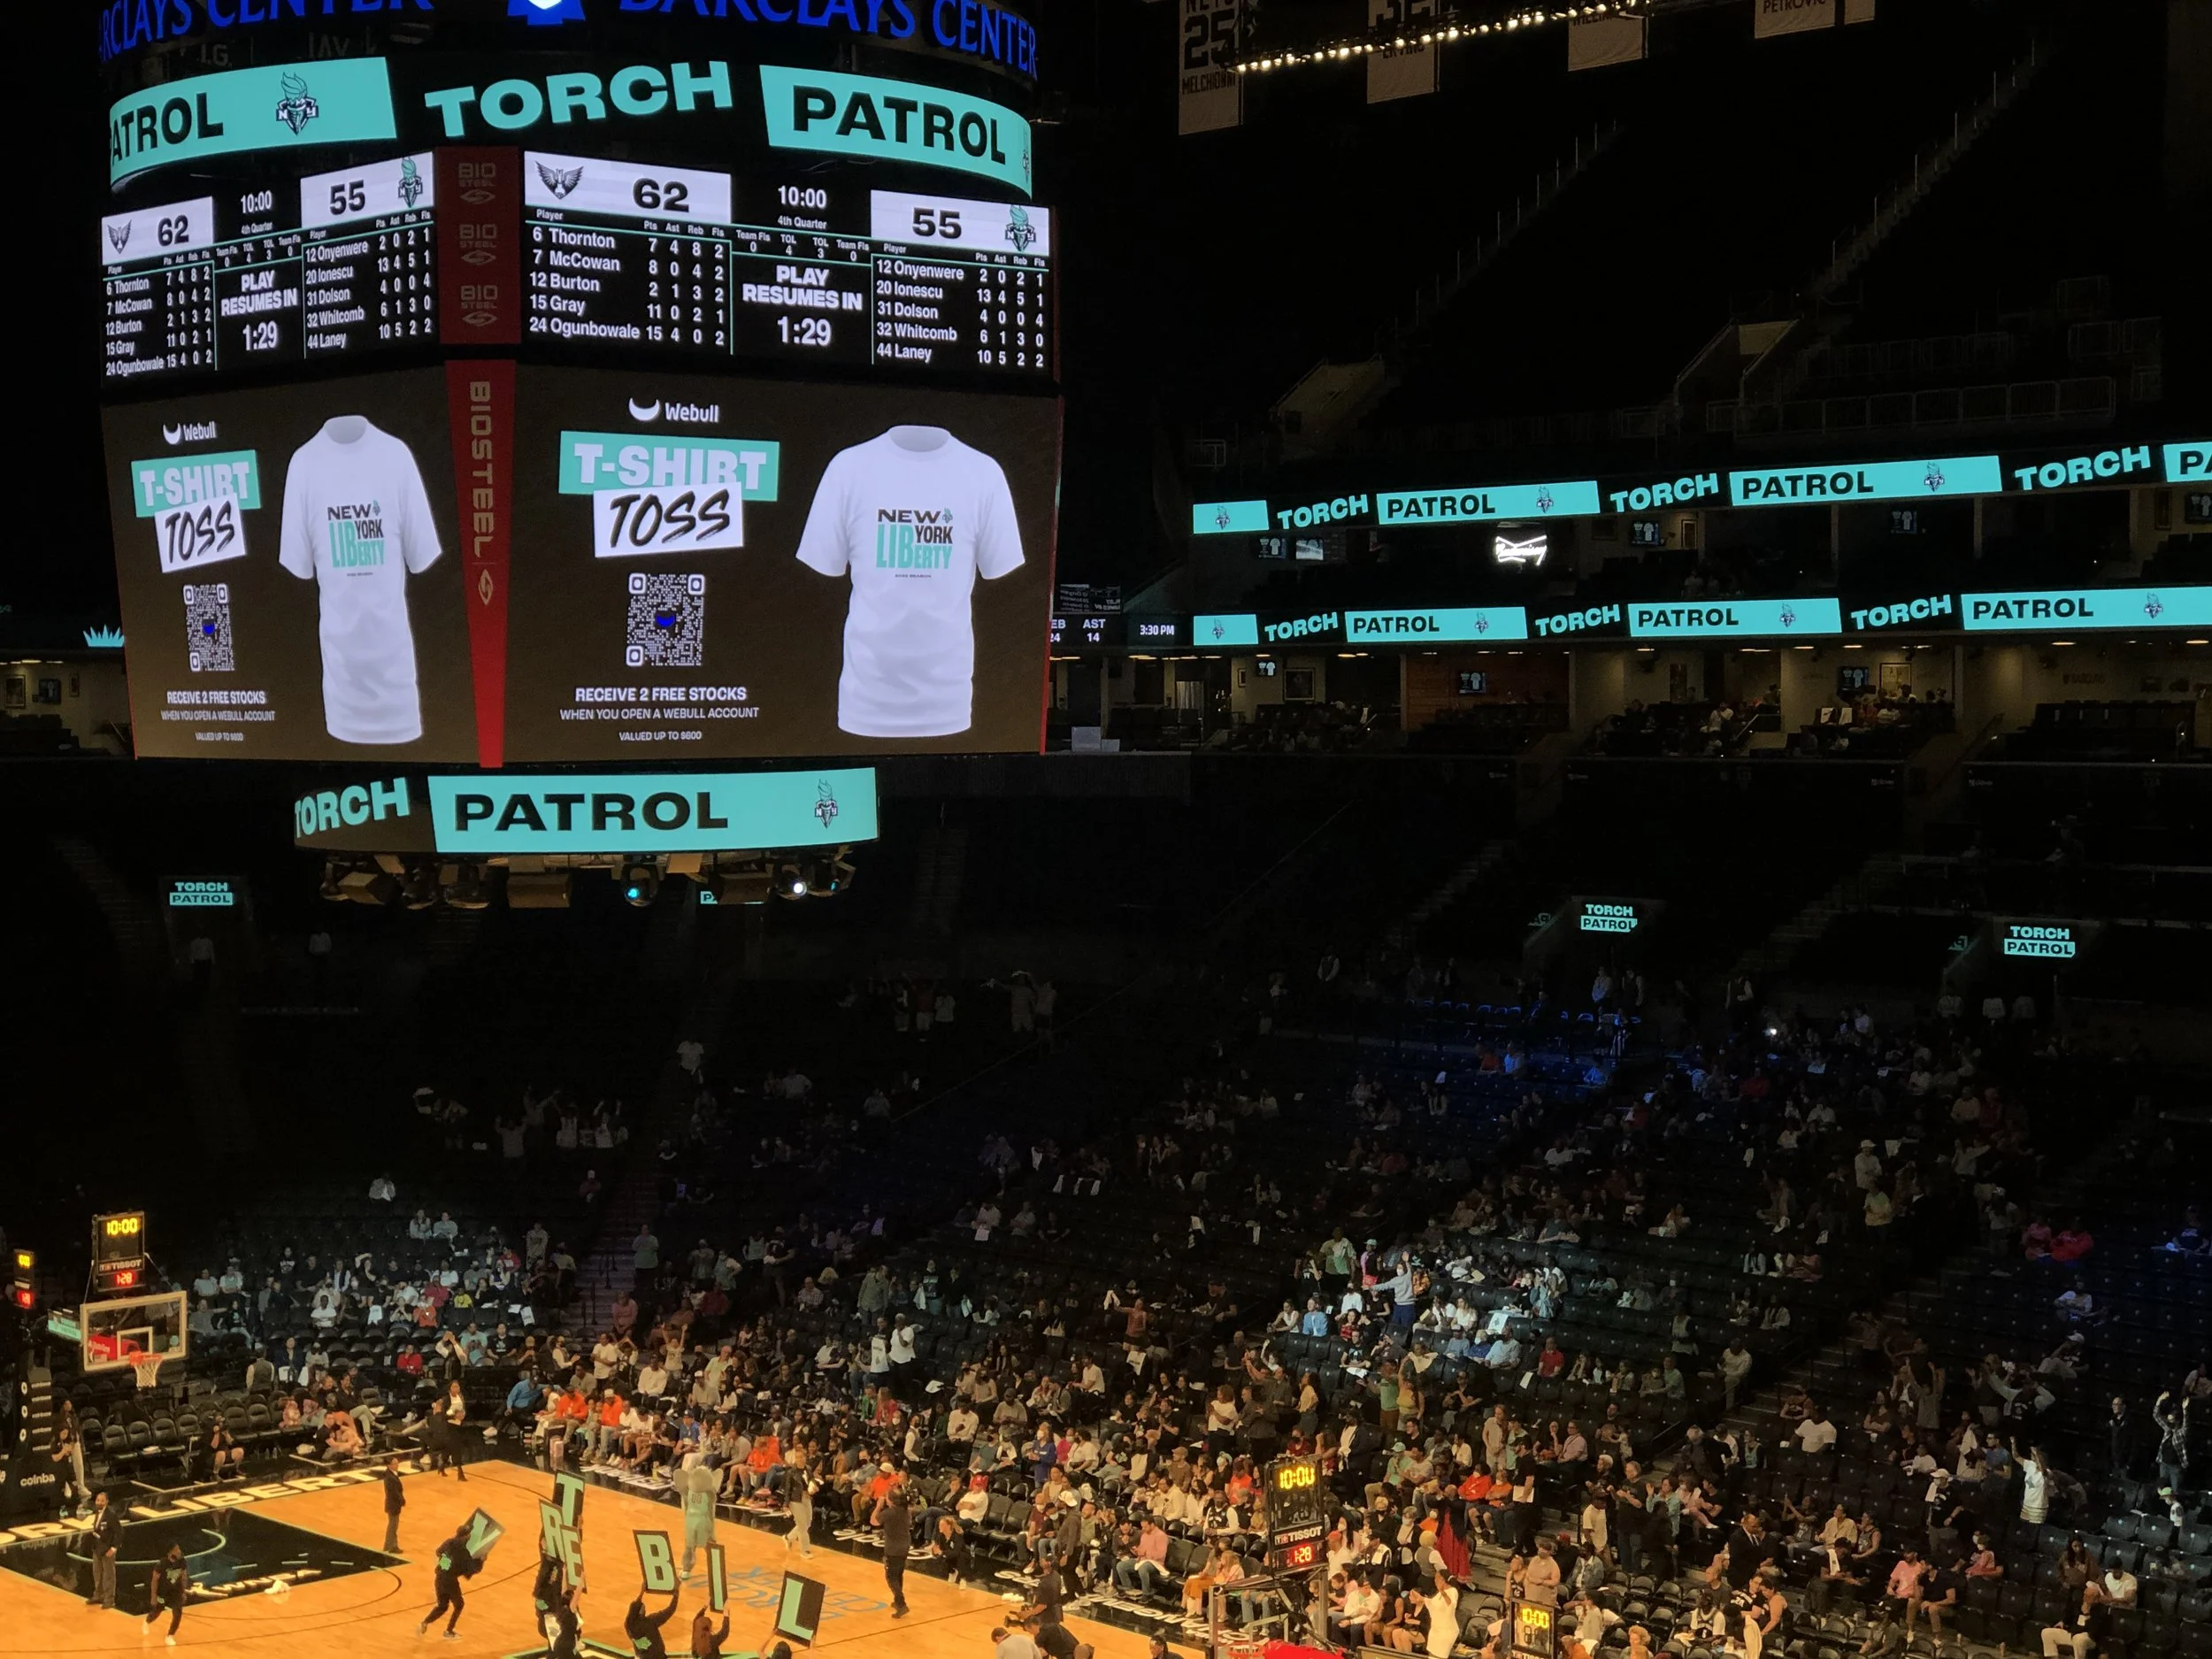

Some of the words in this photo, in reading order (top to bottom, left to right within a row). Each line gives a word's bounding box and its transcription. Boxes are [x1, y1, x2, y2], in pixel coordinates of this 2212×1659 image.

[932, 0, 1037, 81] CENTER
[425, 60, 733, 137] TORCH
[111, 92, 224, 166] ATROL
[793, 84, 1005, 165] PATROL
[458, 163, 496, 177] BIO
[241, 190, 273, 214] 10:00
[329, 180, 365, 215] 55
[633, 178, 690, 212] 62
[778, 185, 827, 208] 10:00
[536, 209, 563, 221] Player
[644, 220, 658, 230] Pts
[778, 215, 792, 226] 4th
[795, 217, 827, 229] Quarter
[912, 207, 962, 239] 55
[157, 215, 189, 246] 62
[459, 224, 497, 238] BIO
[533, 227, 541, 242] 6
[549, 228, 616, 248] Thornton
[736, 230, 757, 240] Team
[780, 234, 796, 244] TOL
[813, 237, 828, 247] TOL
[836, 240, 856, 250] Team
[318, 242, 368, 263] Onyenwere
[533, 250, 542, 264] 7
[549, 251, 620, 272] McCowan
[776, 265, 830, 286] PLAY
[878, 259, 892, 273] 12
[895, 260, 964, 282] Onyenwere
[115, 277, 150, 294] Thornton
[242, 271, 275, 292] PLAY
[531, 273, 547, 287] 12
[550, 273, 600, 292] Burton
[878, 280, 892, 294] 20
[895, 281, 943, 299] Ionescu
[221, 290, 280, 316] RESUMES
[282, 288, 297, 306] IN
[319, 288, 350, 304] Dolson
[460, 284, 497, 301] BIO
[742, 283, 839, 308] RESUMES
[842, 292, 862, 310] IN
[115, 297, 152, 314] McCowan
[531, 296, 547, 310] 15
[550, 296, 586, 316] Gray
[878, 301, 892, 316] 31
[895, 303, 938, 319] Dolson
[319, 307, 365, 325] Whitcomb
[116, 319, 142, 334] Burton
[242, 321, 279, 351] 1:29
[530, 318, 547, 333] 24
[550, 319, 641, 339] Ogunbowale
[778, 317, 832, 346] 1:29
[878, 322, 892, 336] 32
[895, 324, 957, 341] Whitcomb
[116, 340, 134, 356] Gray
[319, 332, 347, 349] Laney
[878, 343, 892, 357] 44
[895, 344, 932, 362] Laney
[116, 355, 164, 376] Ogunbowale
[664, 403, 719, 424] Webull
[184, 421, 216, 441] Webull
[469, 380, 494, 558] BIOSTEEL
[574, 442, 767, 490] T-SHIRT
[2015, 445, 2151, 490] TORCH
[140, 461, 250, 506] T-SHIRT
[1610, 473, 1718, 513] TORCH
[1741, 470, 1874, 500] PATROL
[327, 503, 373, 521] NEW
[609, 489, 731, 549] TOSS
[877, 509, 941, 524] NEW
[1277, 495, 1370, 530] TORCH
[1387, 493, 1495, 519] PATROL
[165, 501, 235, 564] TOSS
[355, 519, 384, 539] YORK
[915, 525, 953, 544] YORK
[876, 524, 953, 569] LIBERTY
[1535, 603, 1620, 635] TORCH
[1637, 608, 1739, 628] PATROL
[1851, 594, 1952, 630] TORCH
[1972, 598, 2093, 620] PATROL
[1083, 619, 1106, 628] AST
[1140, 625, 1158, 635] 3:30
[1160, 625, 1175, 635] PM
[1264, 611, 1339, 641] TORCH
[1352, 615, 1441, 635] PATROL
[1087, 633, 1100, 641] 14
[167, 691, 200, 704] RECEIVE
[202, 691, 208, 703] 2
[209, 691, 229, 703] FREE
[230, 691, 265, 704] STOCKS
[575, 687, 636, 702] RECEIVE
[640, 687, 649, 701] 2
[652, 687, 686, 701] FREE
[689, 687, 747, 700] STOCKS
[559, 710, 593, 719] WHEN
[596, 709, 618, 719] YOU
[621, 709, 650, 718] OPEN
[653, 709, 660, 718] A
[664, 708, 705, 718] WEBULL
[708, 708, 759, 718] ACCOUNT
[619, 732, 652, 741] VALUED
[295, 777, 410, 839] TORCH
[455, 791, 728, 832] PATROL
[174, 882, 228, 892] TORCH
[172, 894, 231, 903] PATROL
[1585, 904, 1633, 917] TORCH
[1582, 918, 1636, 931] PATROL
[2009, 926, 2070, 940] TORCH
[2006, 942, 2074, 956] PATROL
[107, 1217, 137, 1234] 10:00
[20, 1473, 56, 1486] coinba
[1288, 1526, 1323, 1542] TISSOT
[637, 1533, 677, 1592] B
